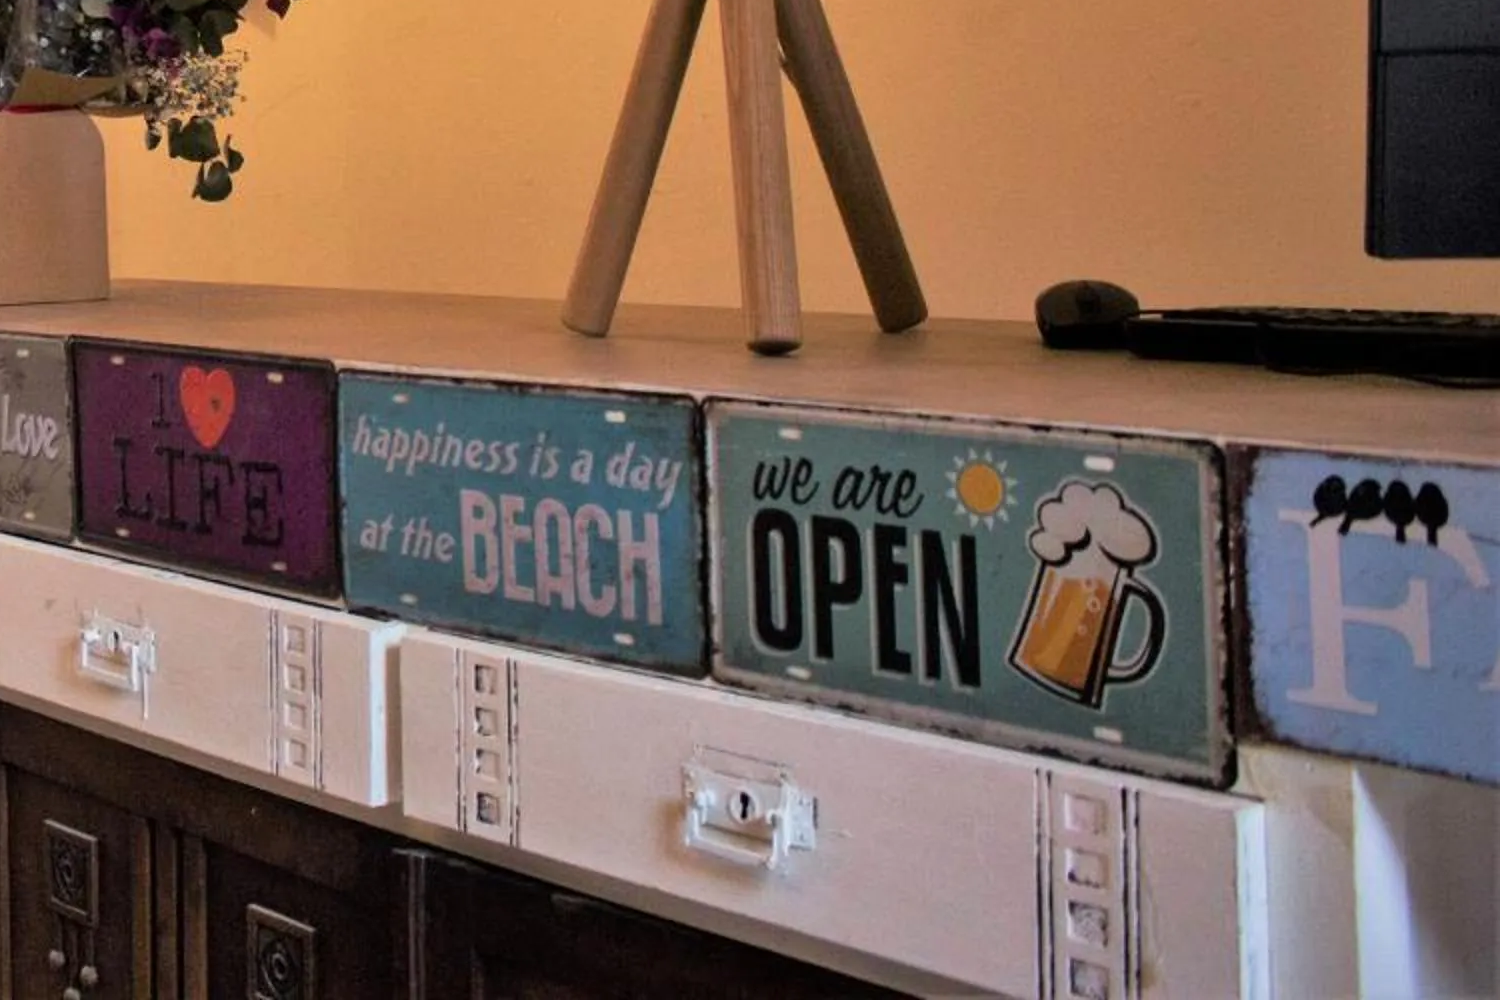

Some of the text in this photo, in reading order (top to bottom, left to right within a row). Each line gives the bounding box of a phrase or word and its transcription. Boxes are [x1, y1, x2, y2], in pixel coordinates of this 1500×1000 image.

[1, 394, 60, 461] Love
[151, 371, 172, 430] I
[112, 437, 285, 547] LIFE
[351, 416, 682, 511] happiness is a day
[752, 454, 925, 519] we are
[359, 488, 665, 627] at the BEACH
[750, 505, 984, 690] OPEN
[1277, 507, 1500, 717] F
